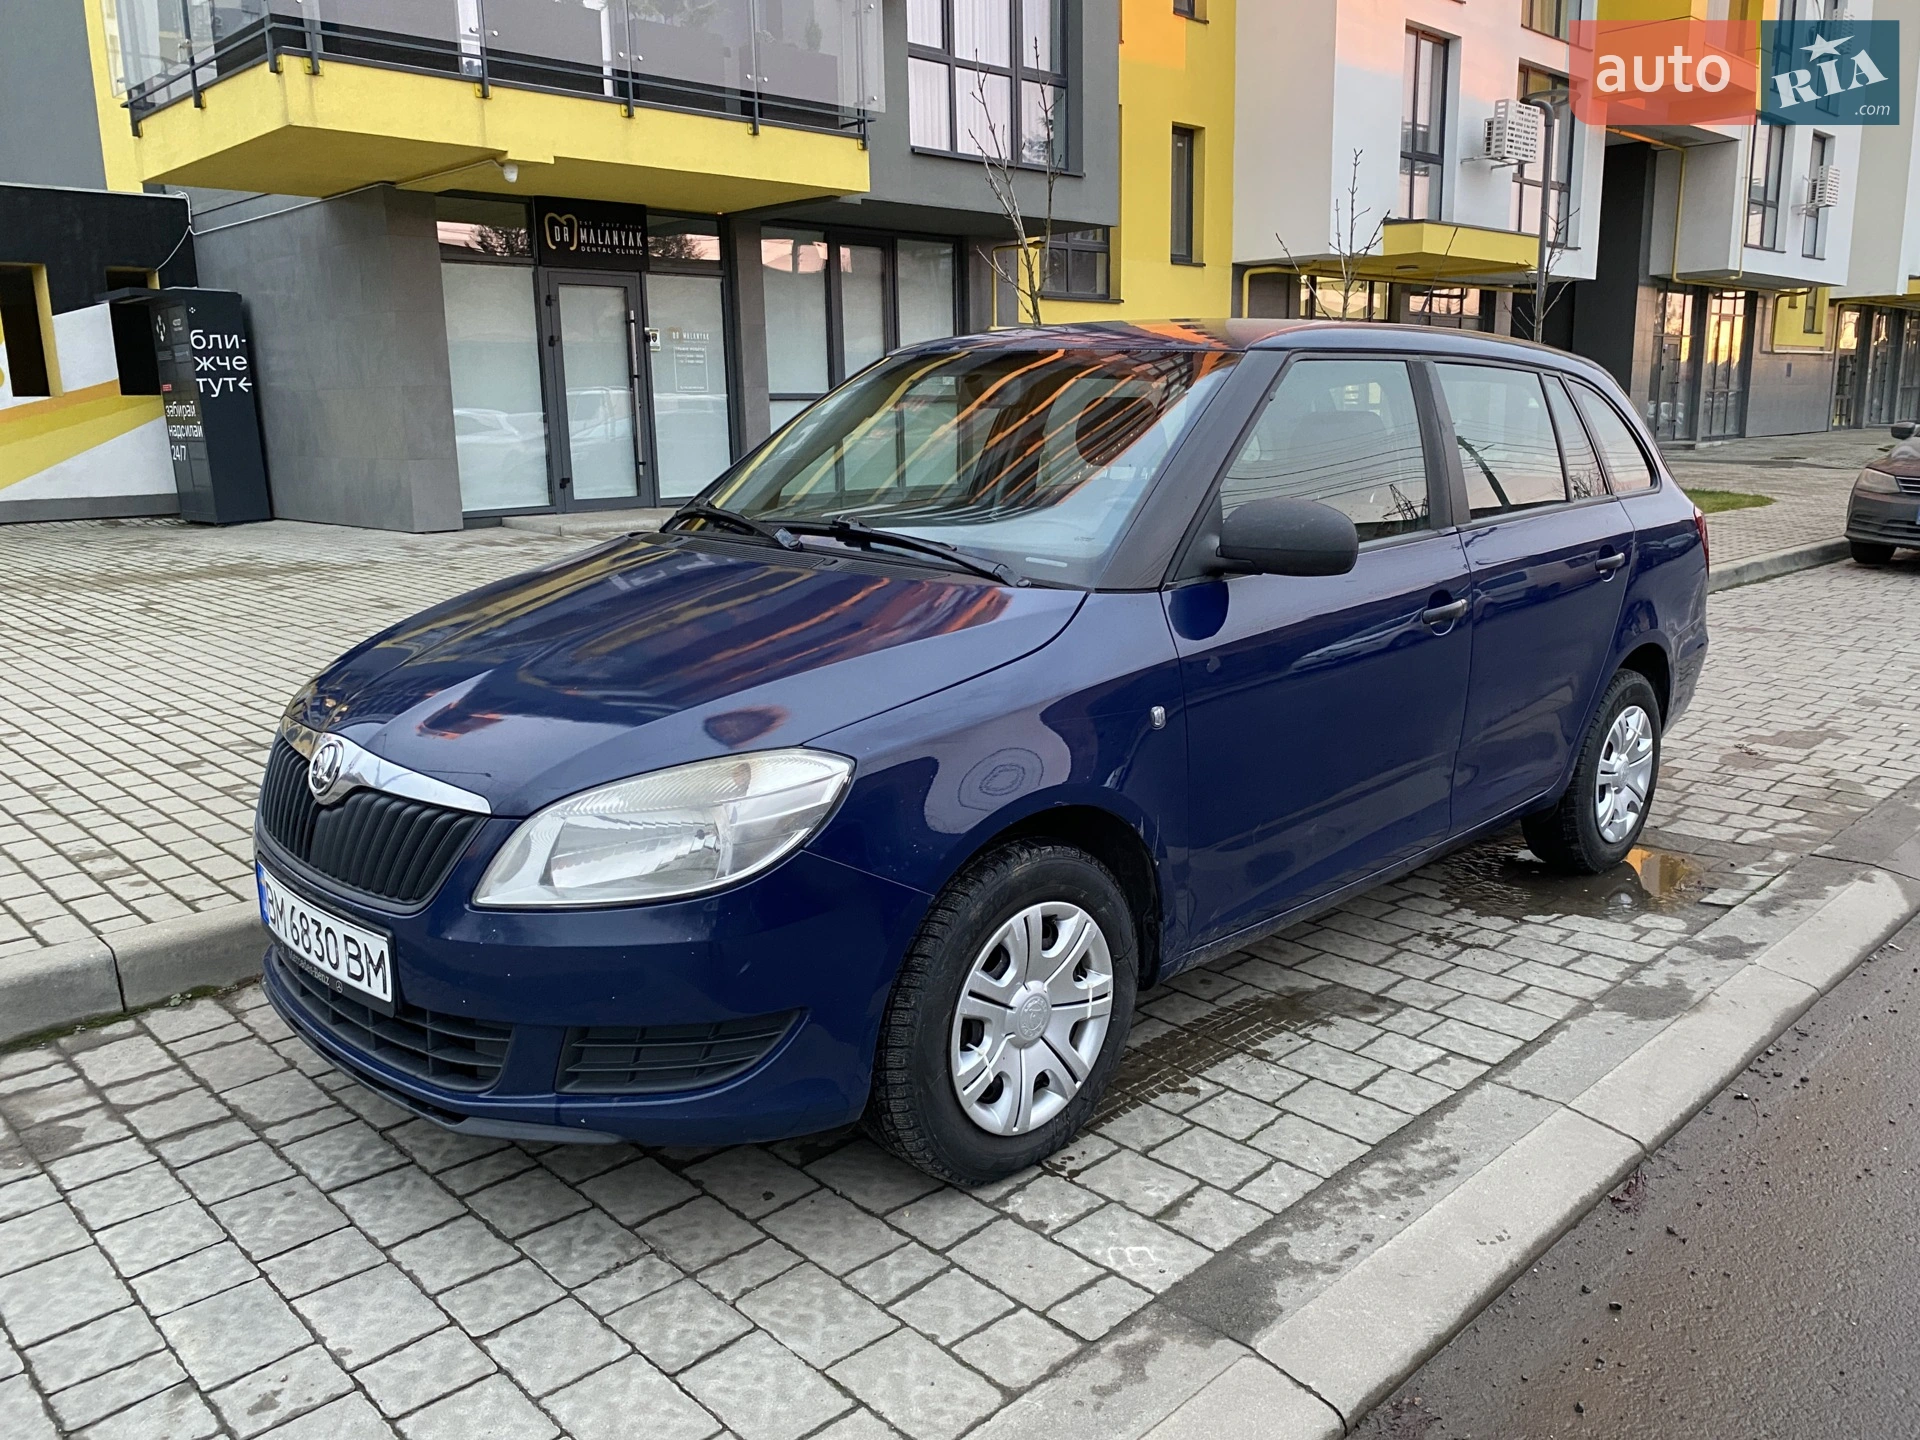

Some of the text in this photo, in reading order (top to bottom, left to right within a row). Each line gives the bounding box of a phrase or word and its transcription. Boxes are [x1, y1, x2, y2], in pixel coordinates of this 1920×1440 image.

[580, 227, 643, 248] MALANYAK
[581, 245, 643, 256] DENTAL CLINIC
[190, 329, 246, 349] бли-
[193, 355, 248, 372] жче
[195, 377, 237, 398] тут
[165, 400, 197, 421] забирай
[168, 421, 204, 439] надсилай
[171, 445, 187, 461] 24/7
